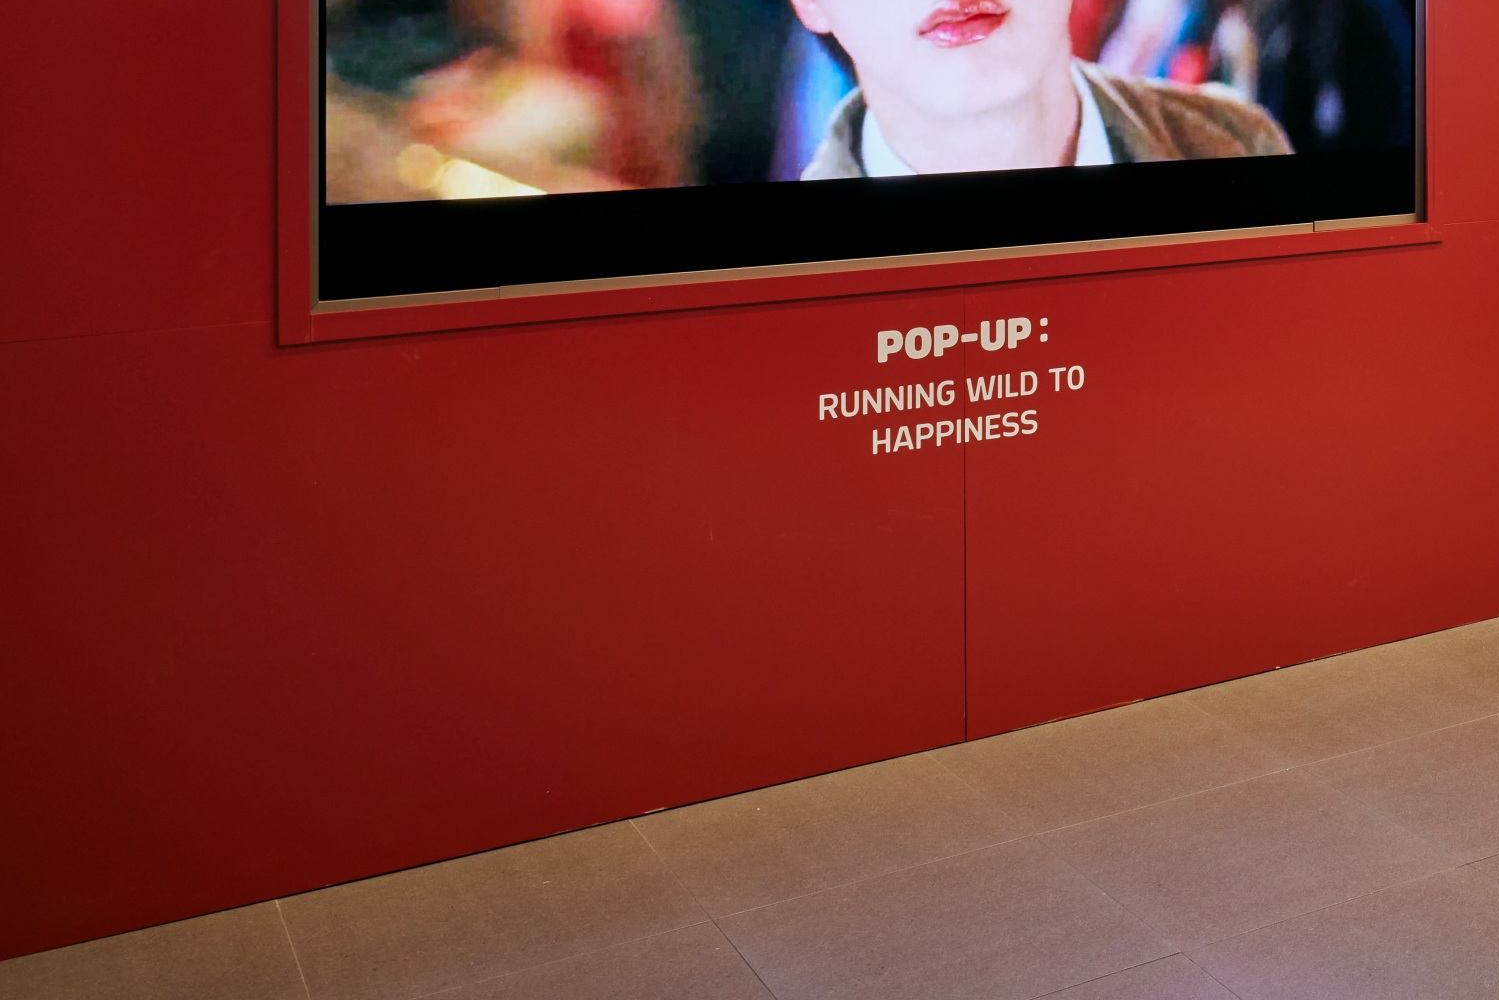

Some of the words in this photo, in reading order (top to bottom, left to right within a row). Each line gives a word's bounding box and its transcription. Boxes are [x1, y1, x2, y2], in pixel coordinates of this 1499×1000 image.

[819, 380, 955, 421] RUNNING
[966, 371, 1038, 403] WILD
[1048, 365, 1085, 392] TO
[872, 409, 1038, 455] HAPPINESS
